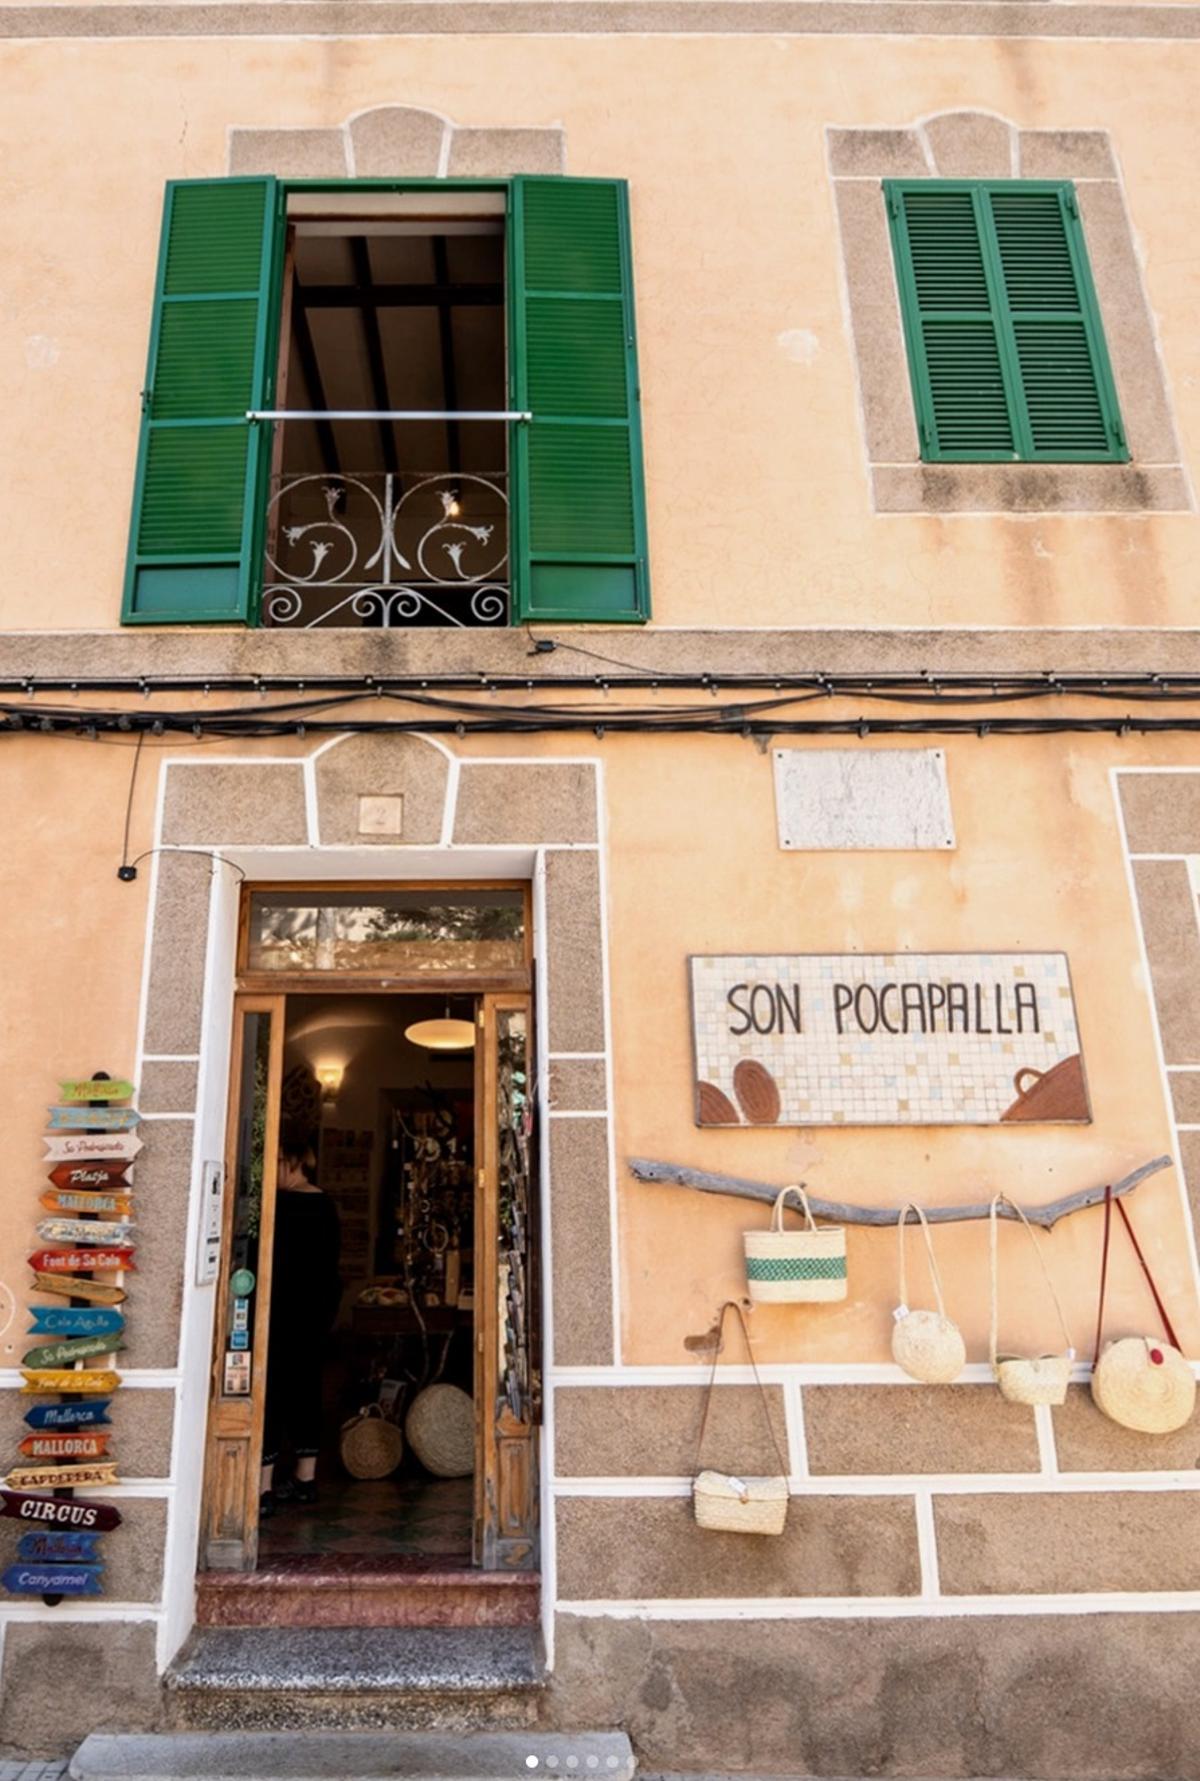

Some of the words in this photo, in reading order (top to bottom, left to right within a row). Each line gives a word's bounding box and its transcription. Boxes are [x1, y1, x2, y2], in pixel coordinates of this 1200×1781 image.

[726, 982, 802, 1035] SON
[834, 981, 1041, 1035] POCAPALLA
[71, 1169, 109, 1185] Platja
[43, 1254, 65, 1267] Font
[67, 1254, 80, 1267] de
[83, 1254, 96, 1267] Sa
[98, 1253, 121, 1267] Cala
[45, 1314, 71, 1329] Cala
[40, 1348, 55, 1365] Sa
[44, 1407, 95, 1425] Mallorca
[32, 1438, 97, 1456] MALLORCA
[20, 1470, 103, 1486] CAPDEPERA
[20, 1500, 97, 1525] CIRCUS
[18, 1572, 88, 1588] Canyamel
